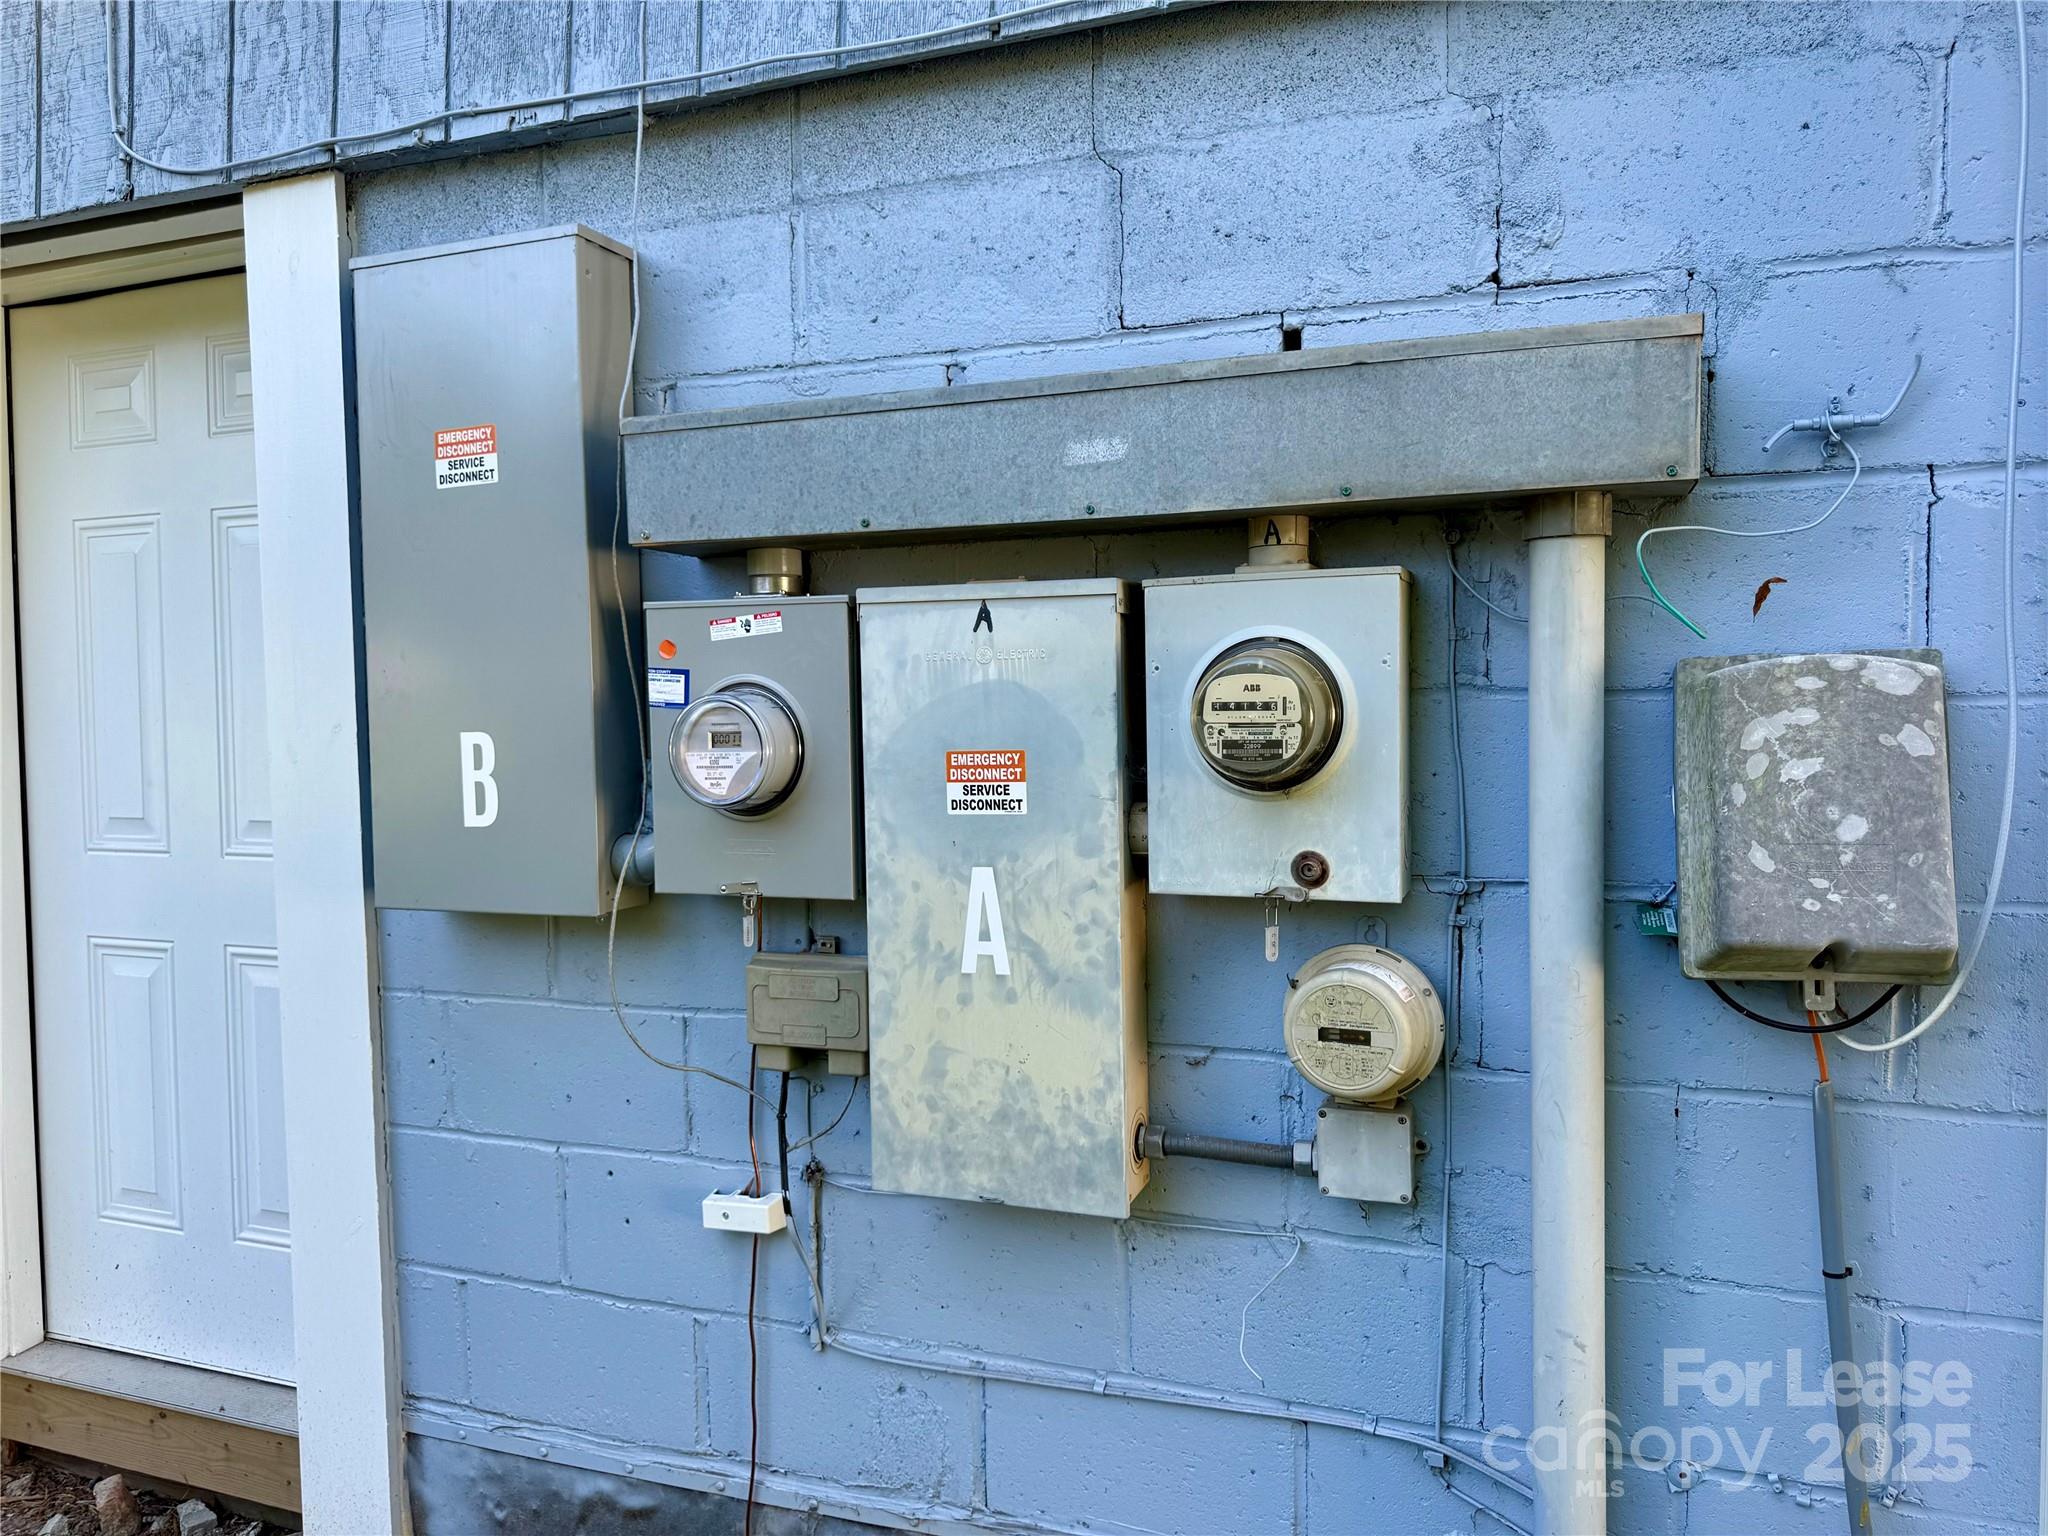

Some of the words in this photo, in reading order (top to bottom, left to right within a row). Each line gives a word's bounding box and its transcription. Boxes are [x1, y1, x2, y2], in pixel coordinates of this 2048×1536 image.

[438, 427, 492, 444] EMERGENCY
[437, 440, 493, 458] DISCONNECT
[448, 457, 485, 471] SERVICE
[440, 469, 495, 485] DISCONNECT
[1264, 519, 1281, 545] A
[973, 600, 993, 633] A
[996, 647, 1047, 661] ELECTRIC
[1243, 684, 1261, 692] ABB
[951, 753, 1020, 766] EMERGENCY
[460, 731, 499, 827] B
[950, 768, 1022, 780] DISCONNECT
[962, 784, 1010, 796] SERVICE
[951, 799, 1023, 811] DISCONNECT
[961, 866, 1011, 975] A
